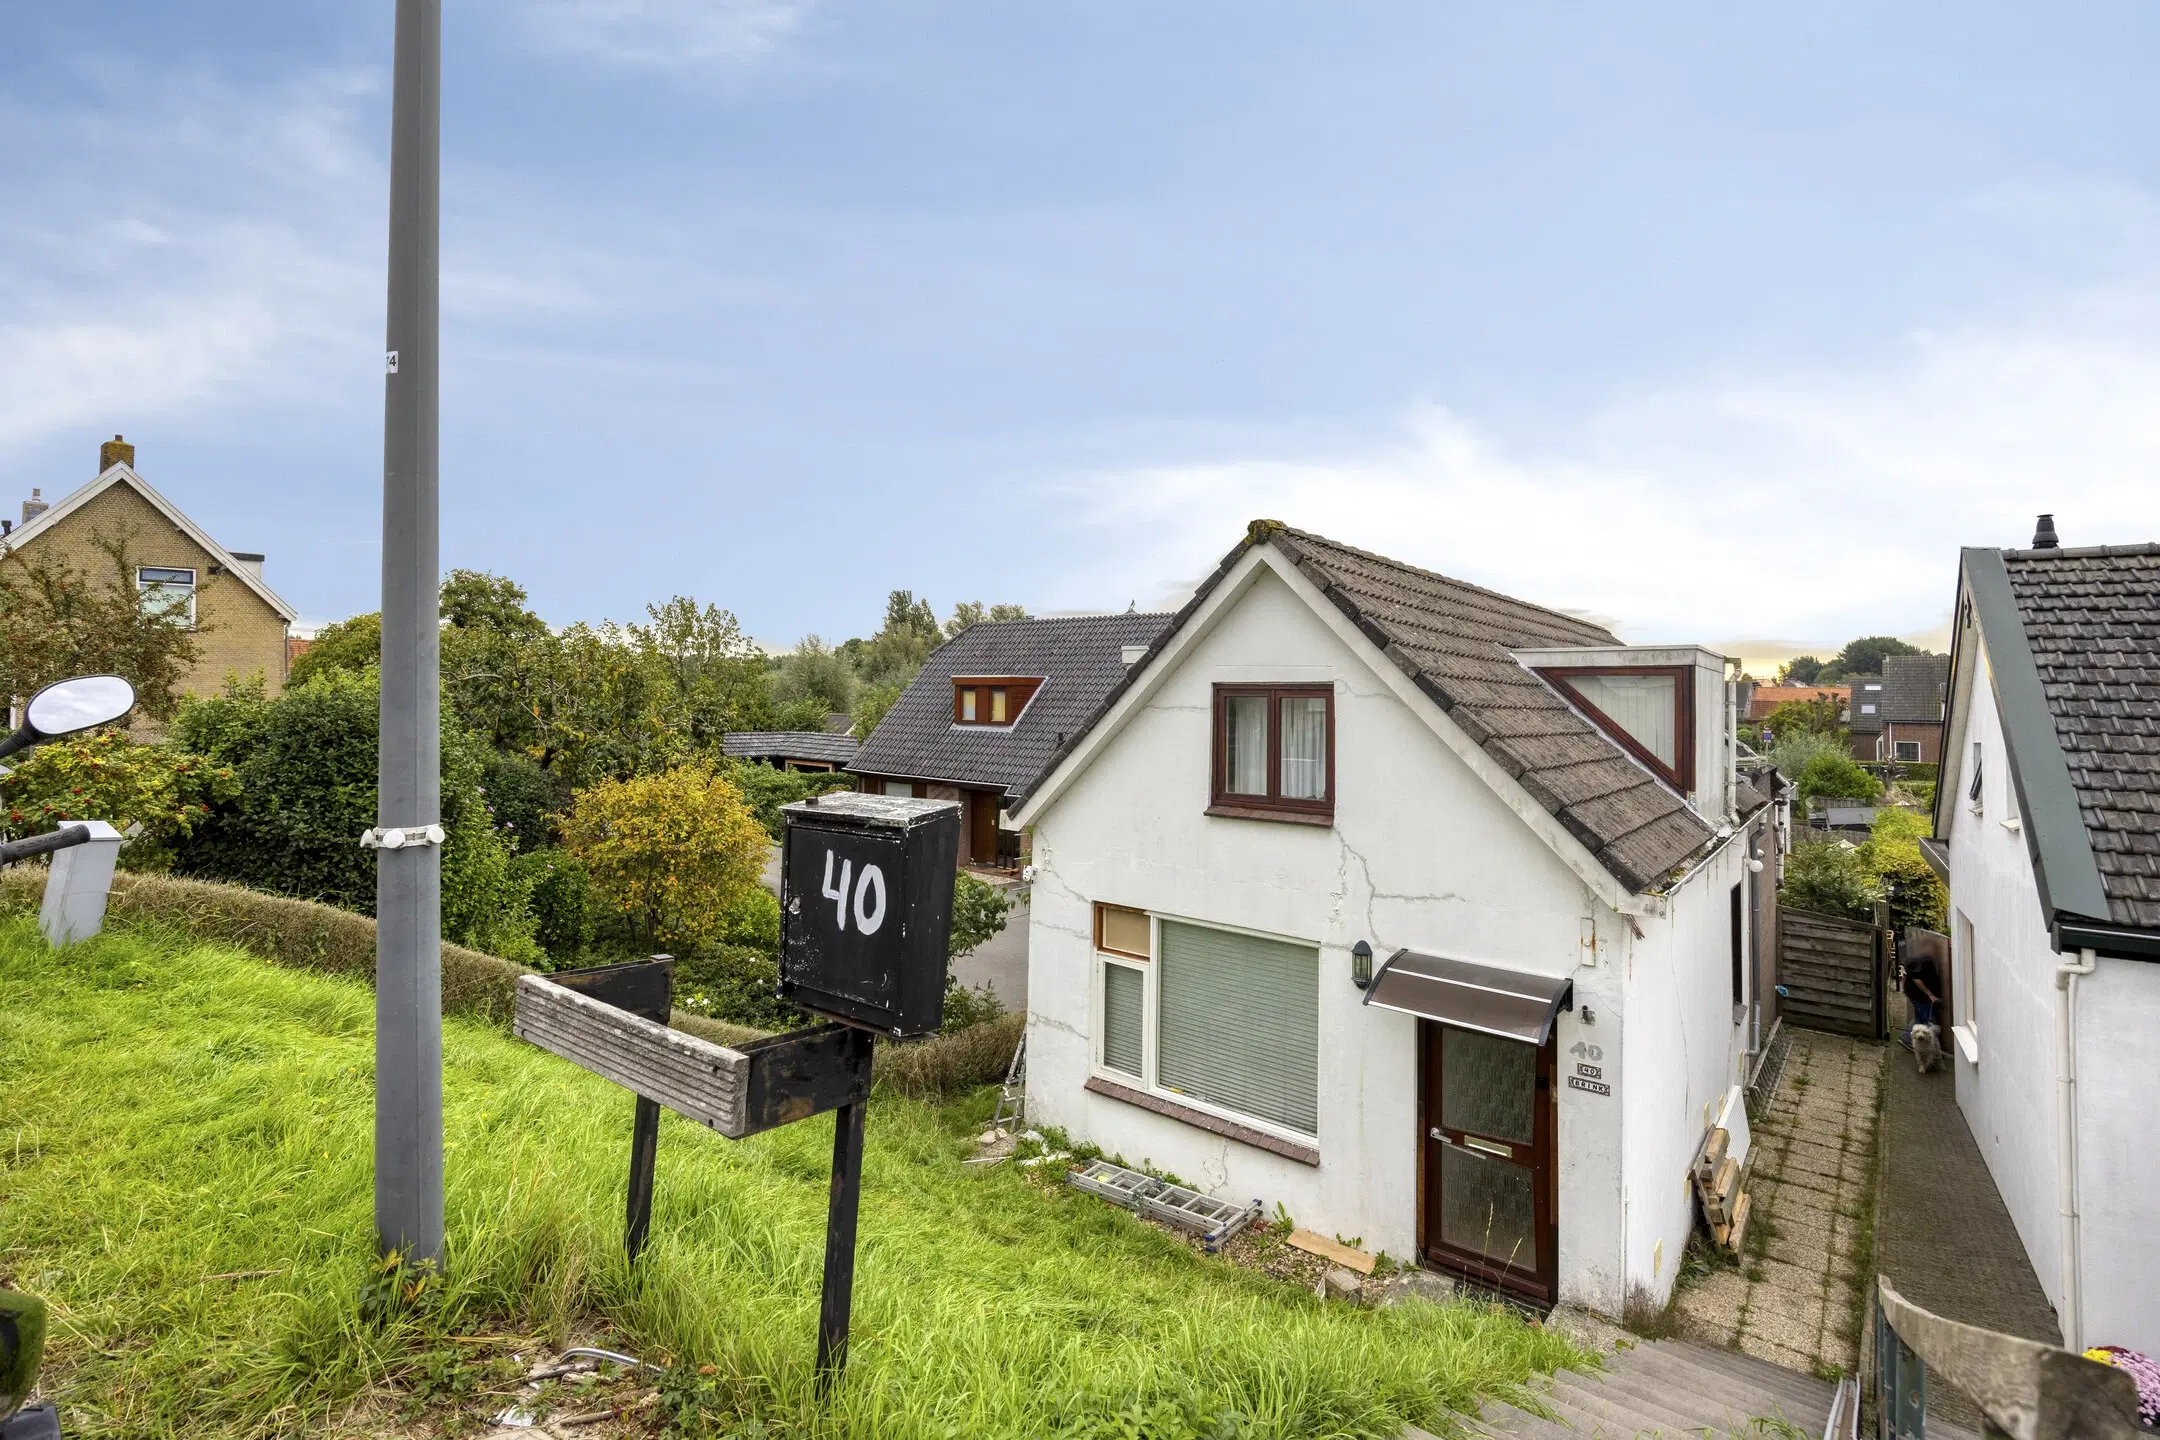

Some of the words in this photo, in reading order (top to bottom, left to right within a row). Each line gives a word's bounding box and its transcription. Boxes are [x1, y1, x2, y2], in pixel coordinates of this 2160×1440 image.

[822, 849, 886, 935] 40
[1570, 1041, 1603, 1061] 40
[1584, 1067, 1595, 1075] 40
[1575, 1080, 1605, 1092] BRINK
